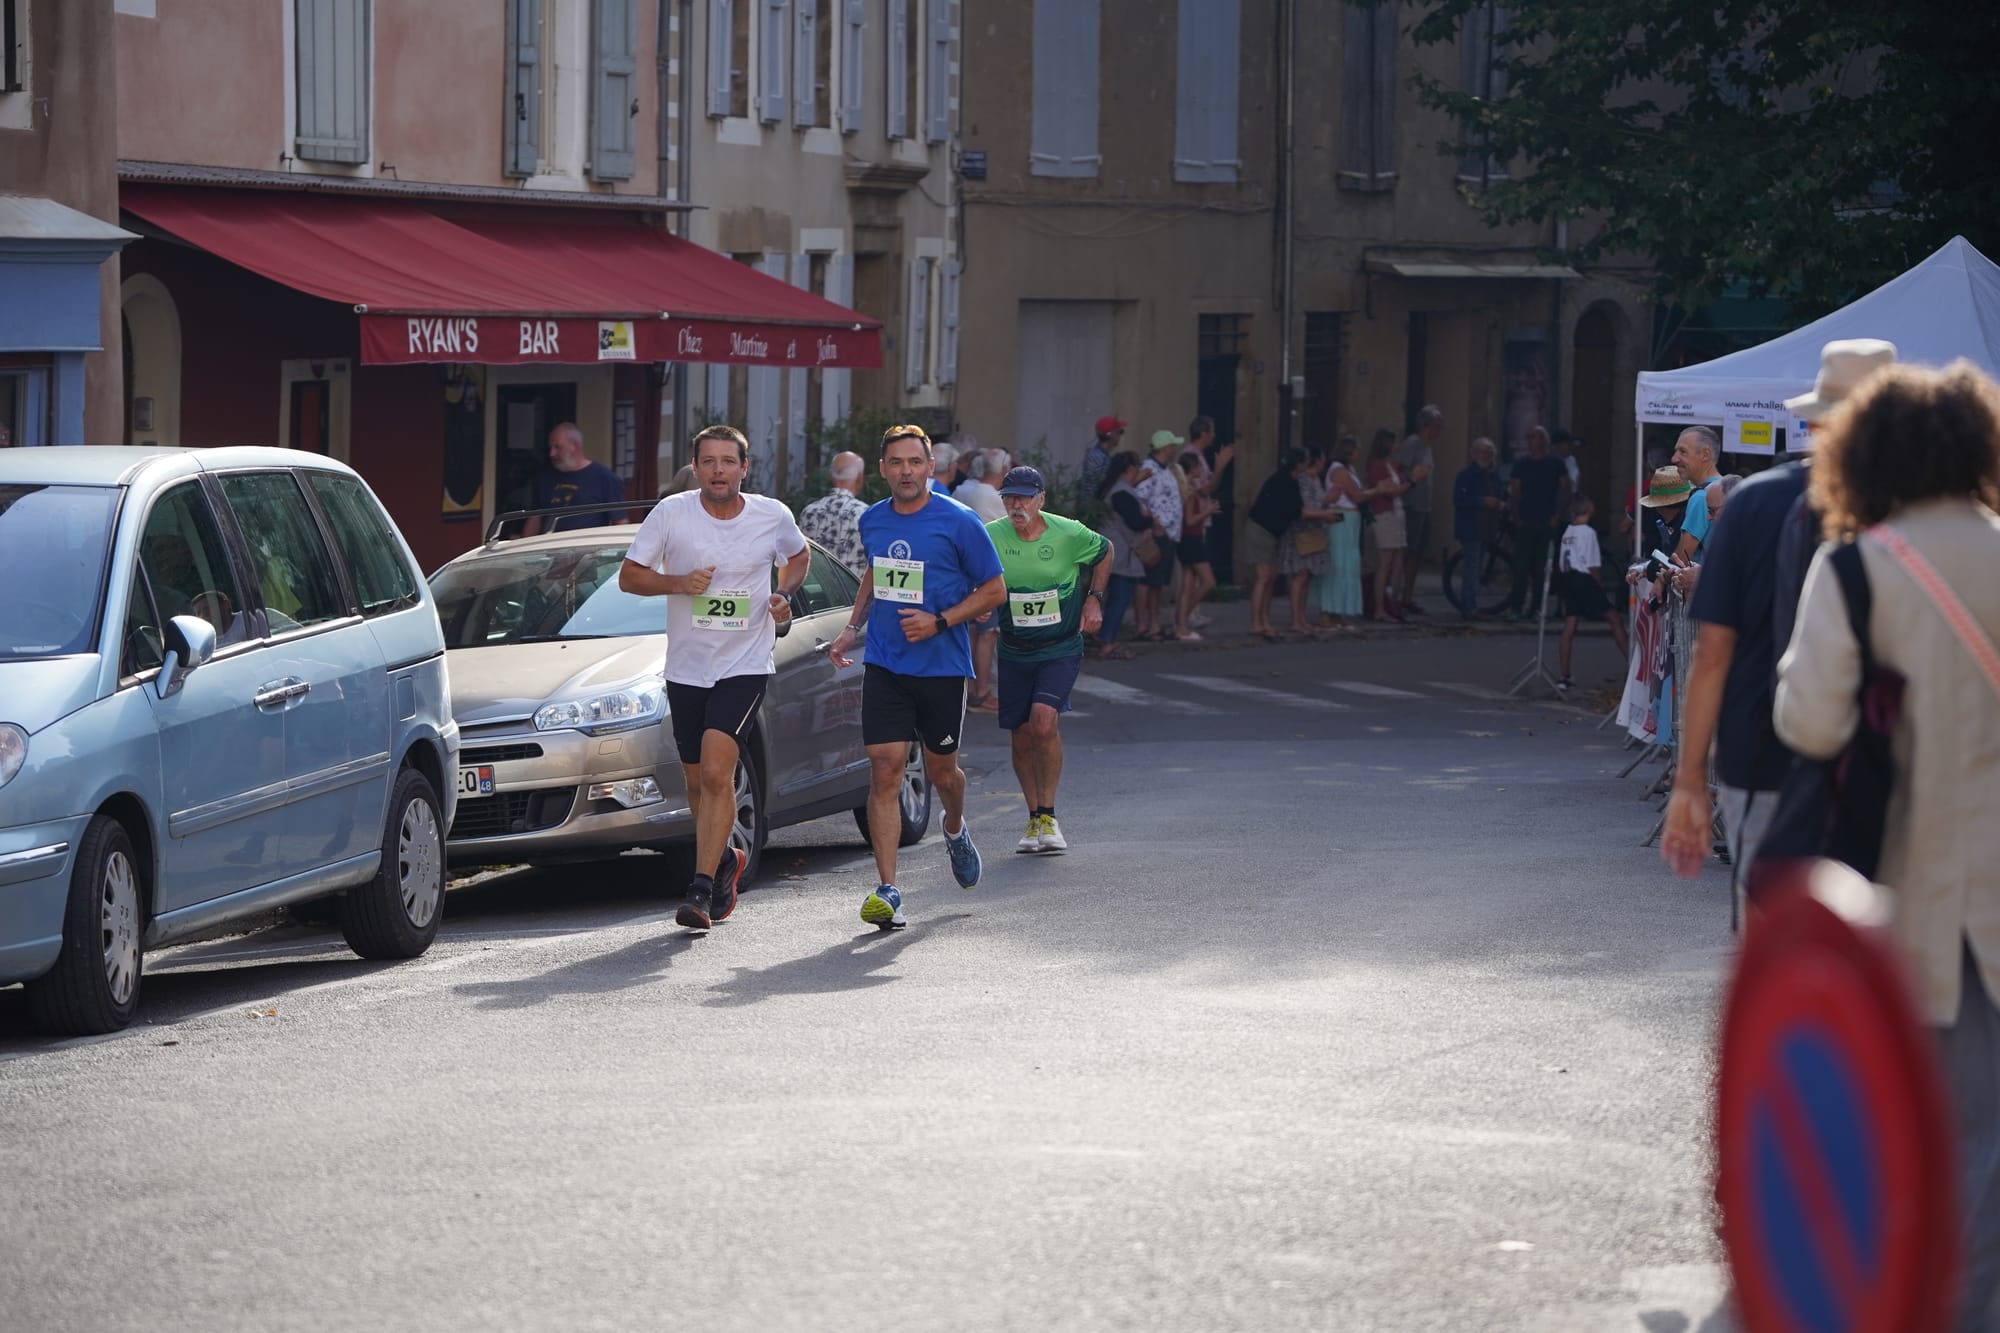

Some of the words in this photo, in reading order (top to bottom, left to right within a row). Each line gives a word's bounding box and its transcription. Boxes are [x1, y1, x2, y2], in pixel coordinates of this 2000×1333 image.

[407, 318, 478, 354] RYAN'S
[519, 321, 560, 354] BAR
[678, 325, 703, 354] Chez
[729, 331, 769, 358] Martine
[815, 334, 838, 365] John
[886, 570, 909, 588] 17
[707, 599, 736, 617] 29
[1022, 601, 1046, 616] 87
[480, 780, 492, 791] 48
